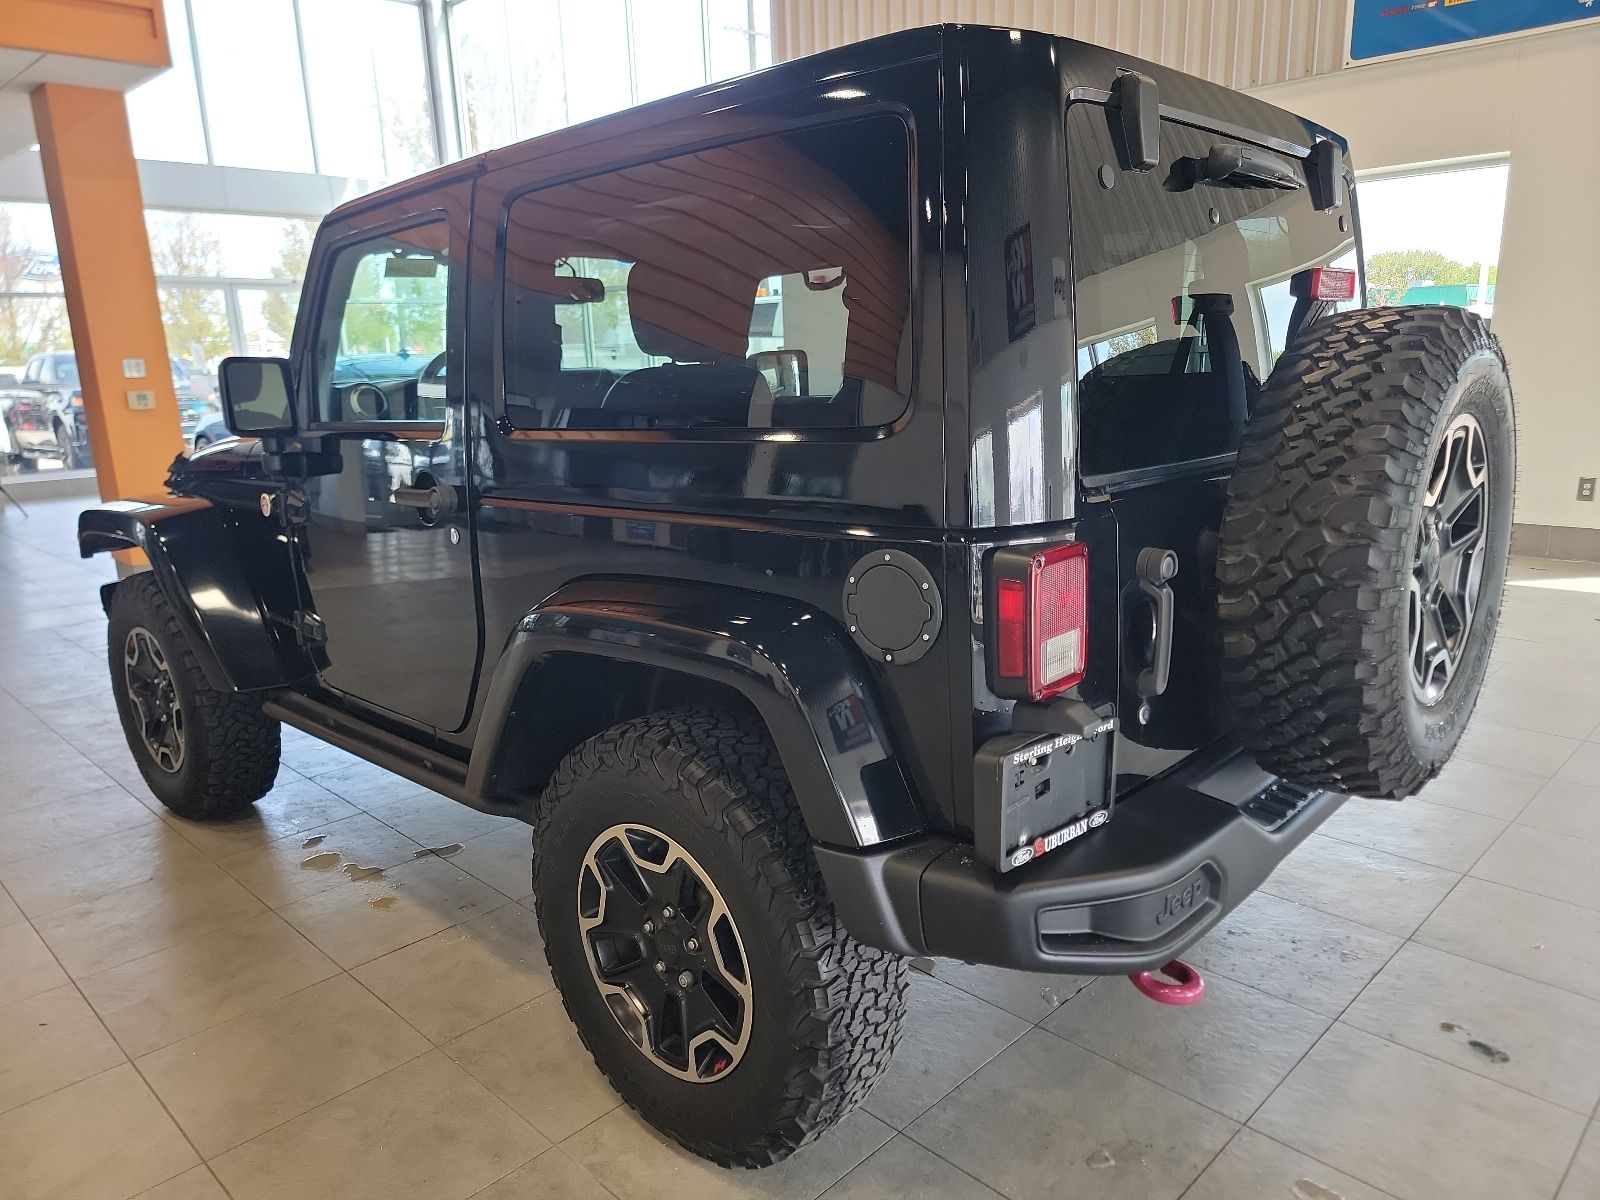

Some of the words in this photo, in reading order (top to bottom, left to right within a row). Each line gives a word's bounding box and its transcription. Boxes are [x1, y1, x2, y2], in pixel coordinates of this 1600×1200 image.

[1013, 743, 1054, 765] Sterling
[1054, 734, 1083, 749] Heig
[1012, 848, 1033, 865] Ford
[1035, 818, 1089, 858] SUBURBAN
[1089, 811, 1107, 827] Ford
[1156, 879, 1201, 925] Jeep
